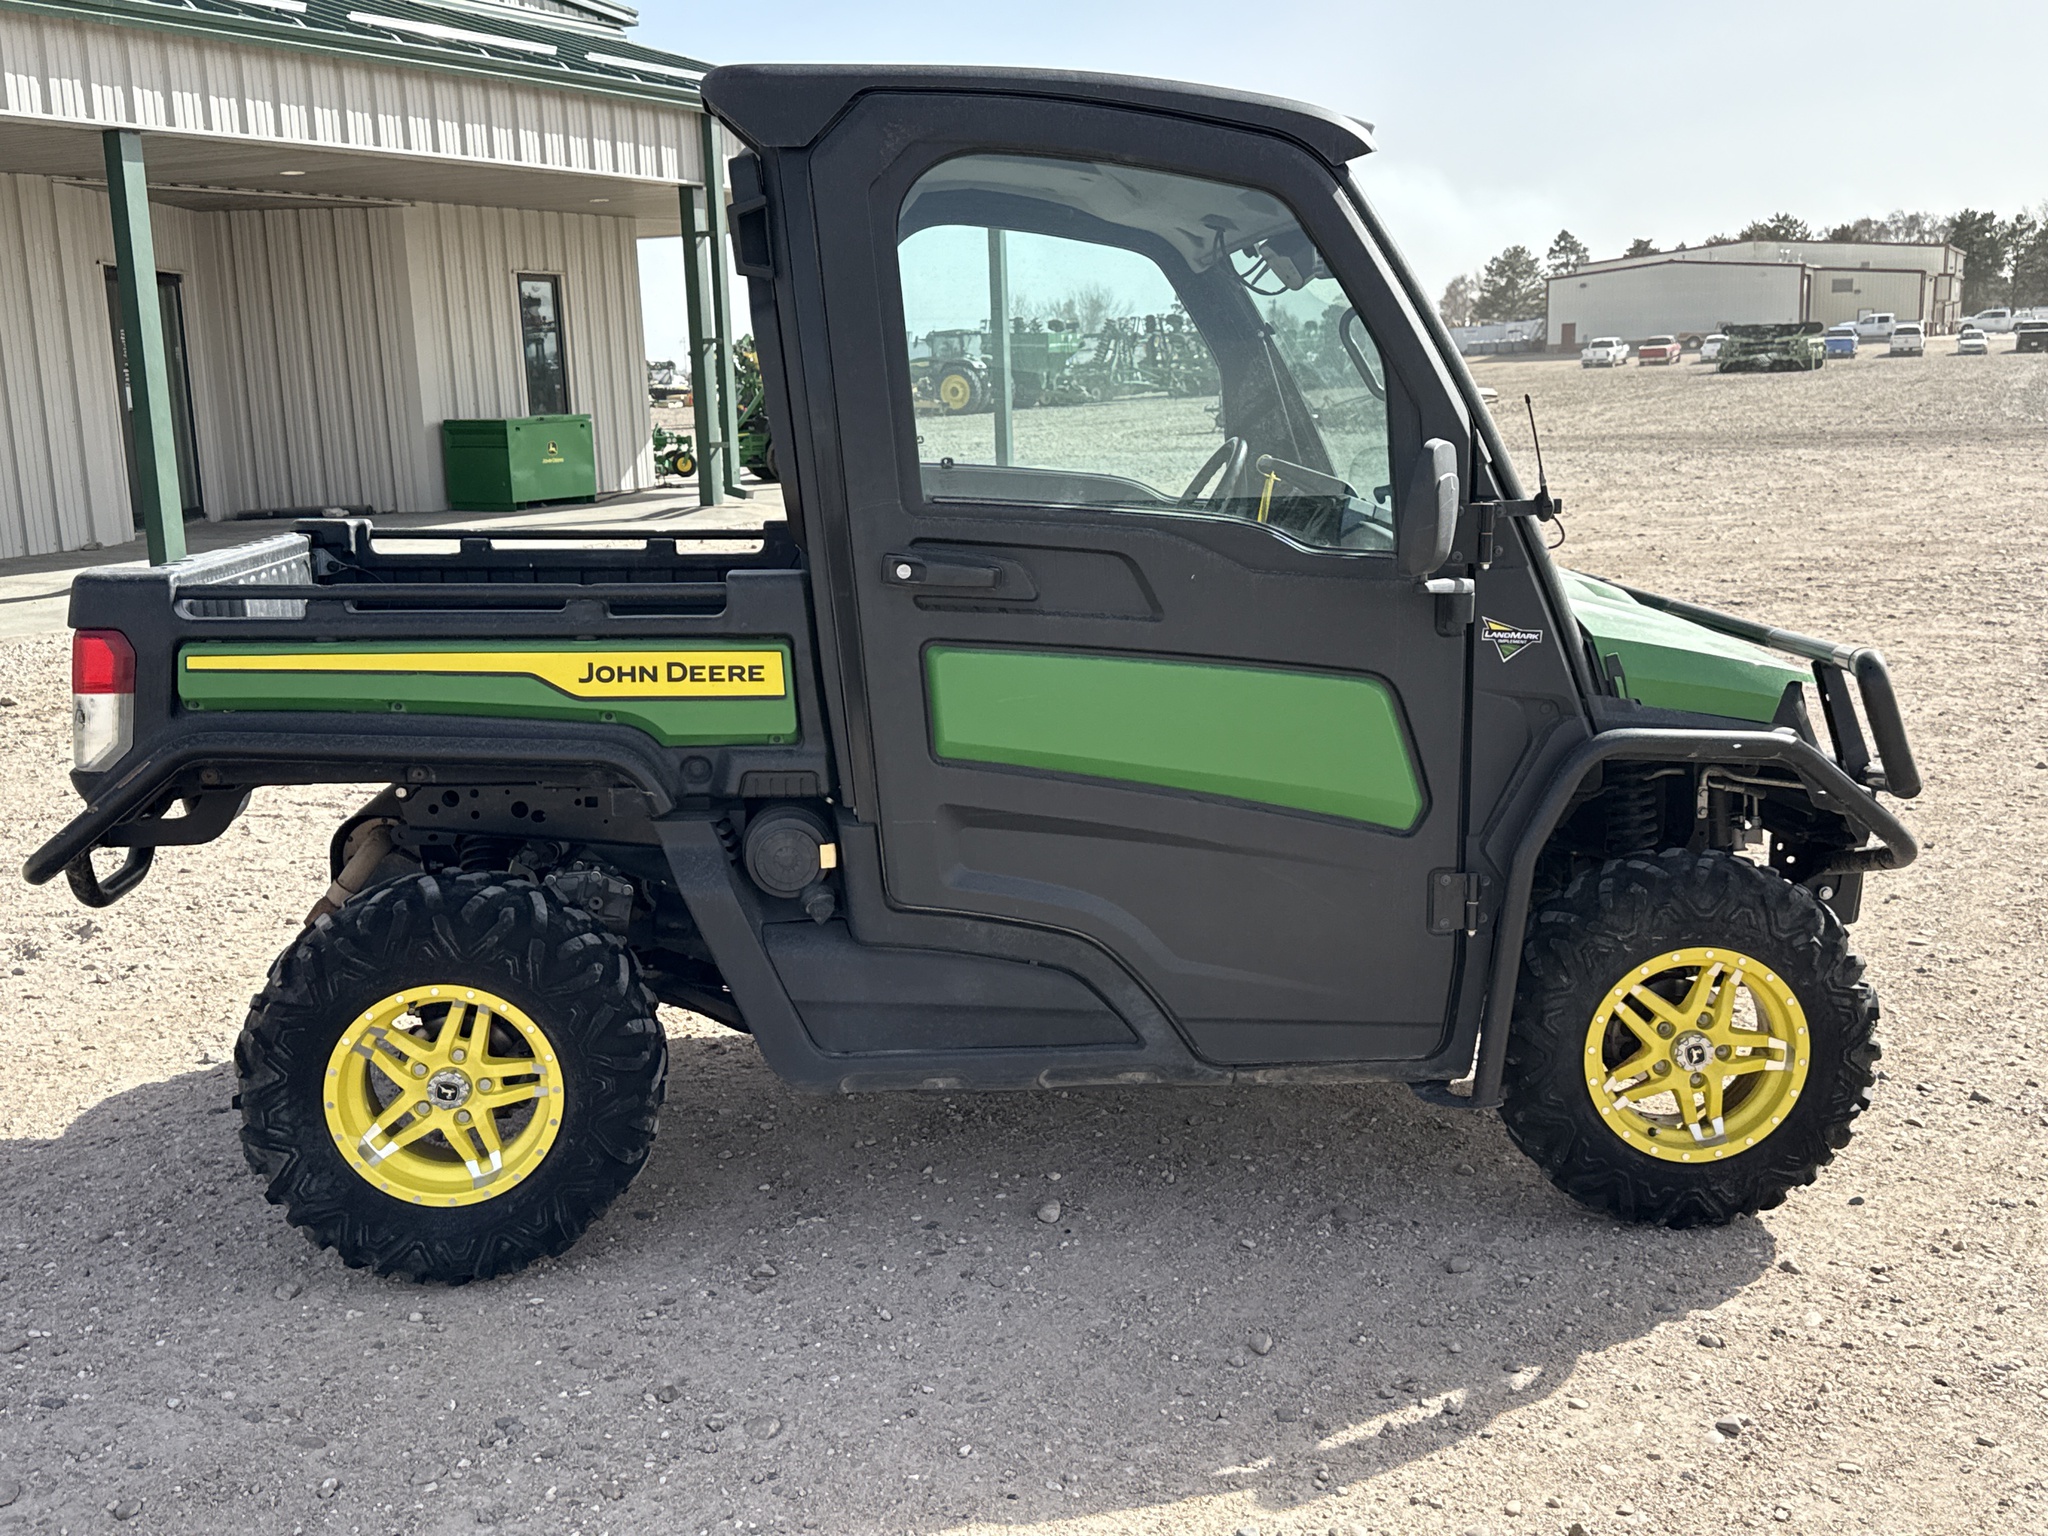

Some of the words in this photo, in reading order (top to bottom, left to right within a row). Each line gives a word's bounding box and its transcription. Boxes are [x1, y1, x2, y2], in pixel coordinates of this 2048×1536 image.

[1484, 630, 1540, 640] LANDMARK
[578, 662, 658, 684] JOHN
[666, 661, 765, 683] DEERE
